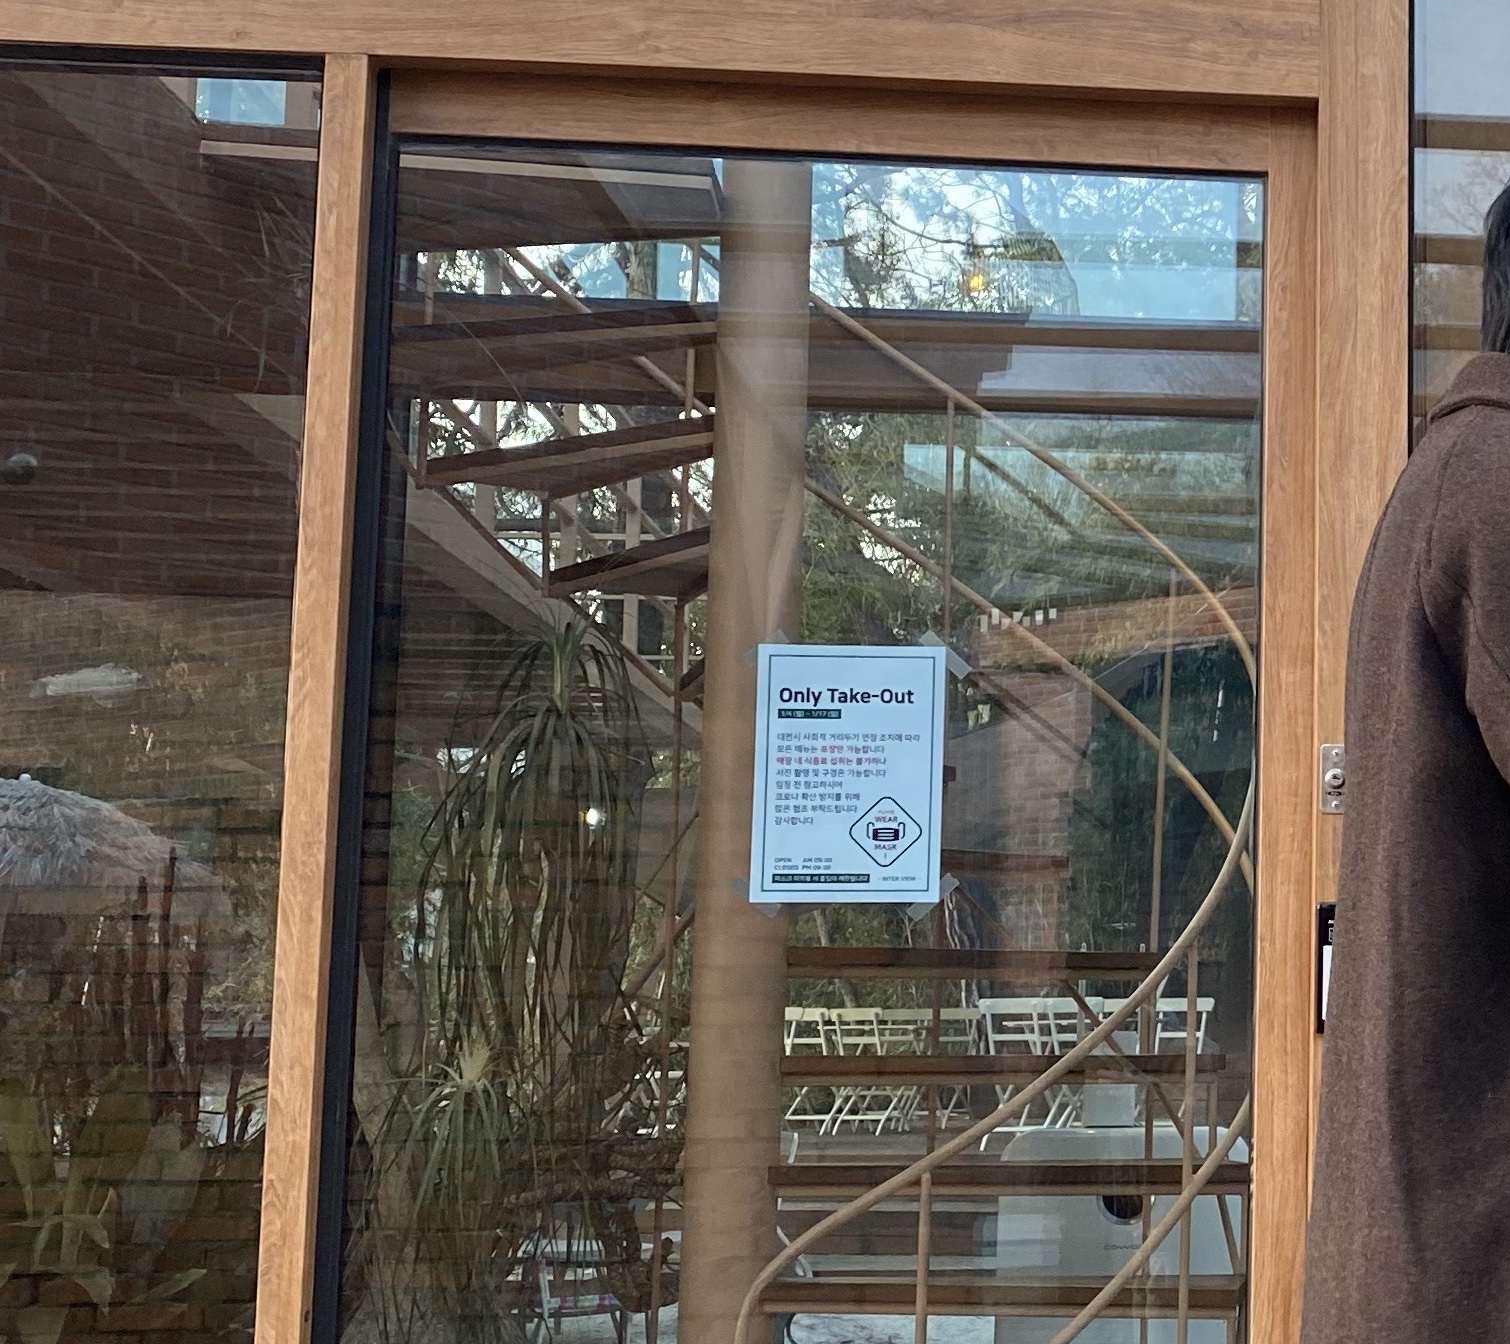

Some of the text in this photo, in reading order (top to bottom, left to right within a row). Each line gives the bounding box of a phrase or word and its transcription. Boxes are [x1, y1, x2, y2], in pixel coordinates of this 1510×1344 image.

[779, 687, 915, 707] Only Take-Out
[904, 733, 920, 743] 따라
[794, 744, 818, 753] 메뉴는
[846, 744, 885, 754] 가능합니다
[776, 768, 792, 777] 사진
[822, 768, 845, 777] 구경은
[847, 768, 887, 777] 가능합니다
[775, 792, 860, 802] 코로나 확산 방지를 위해
[774, 816, 814, 826] 감사합니다
